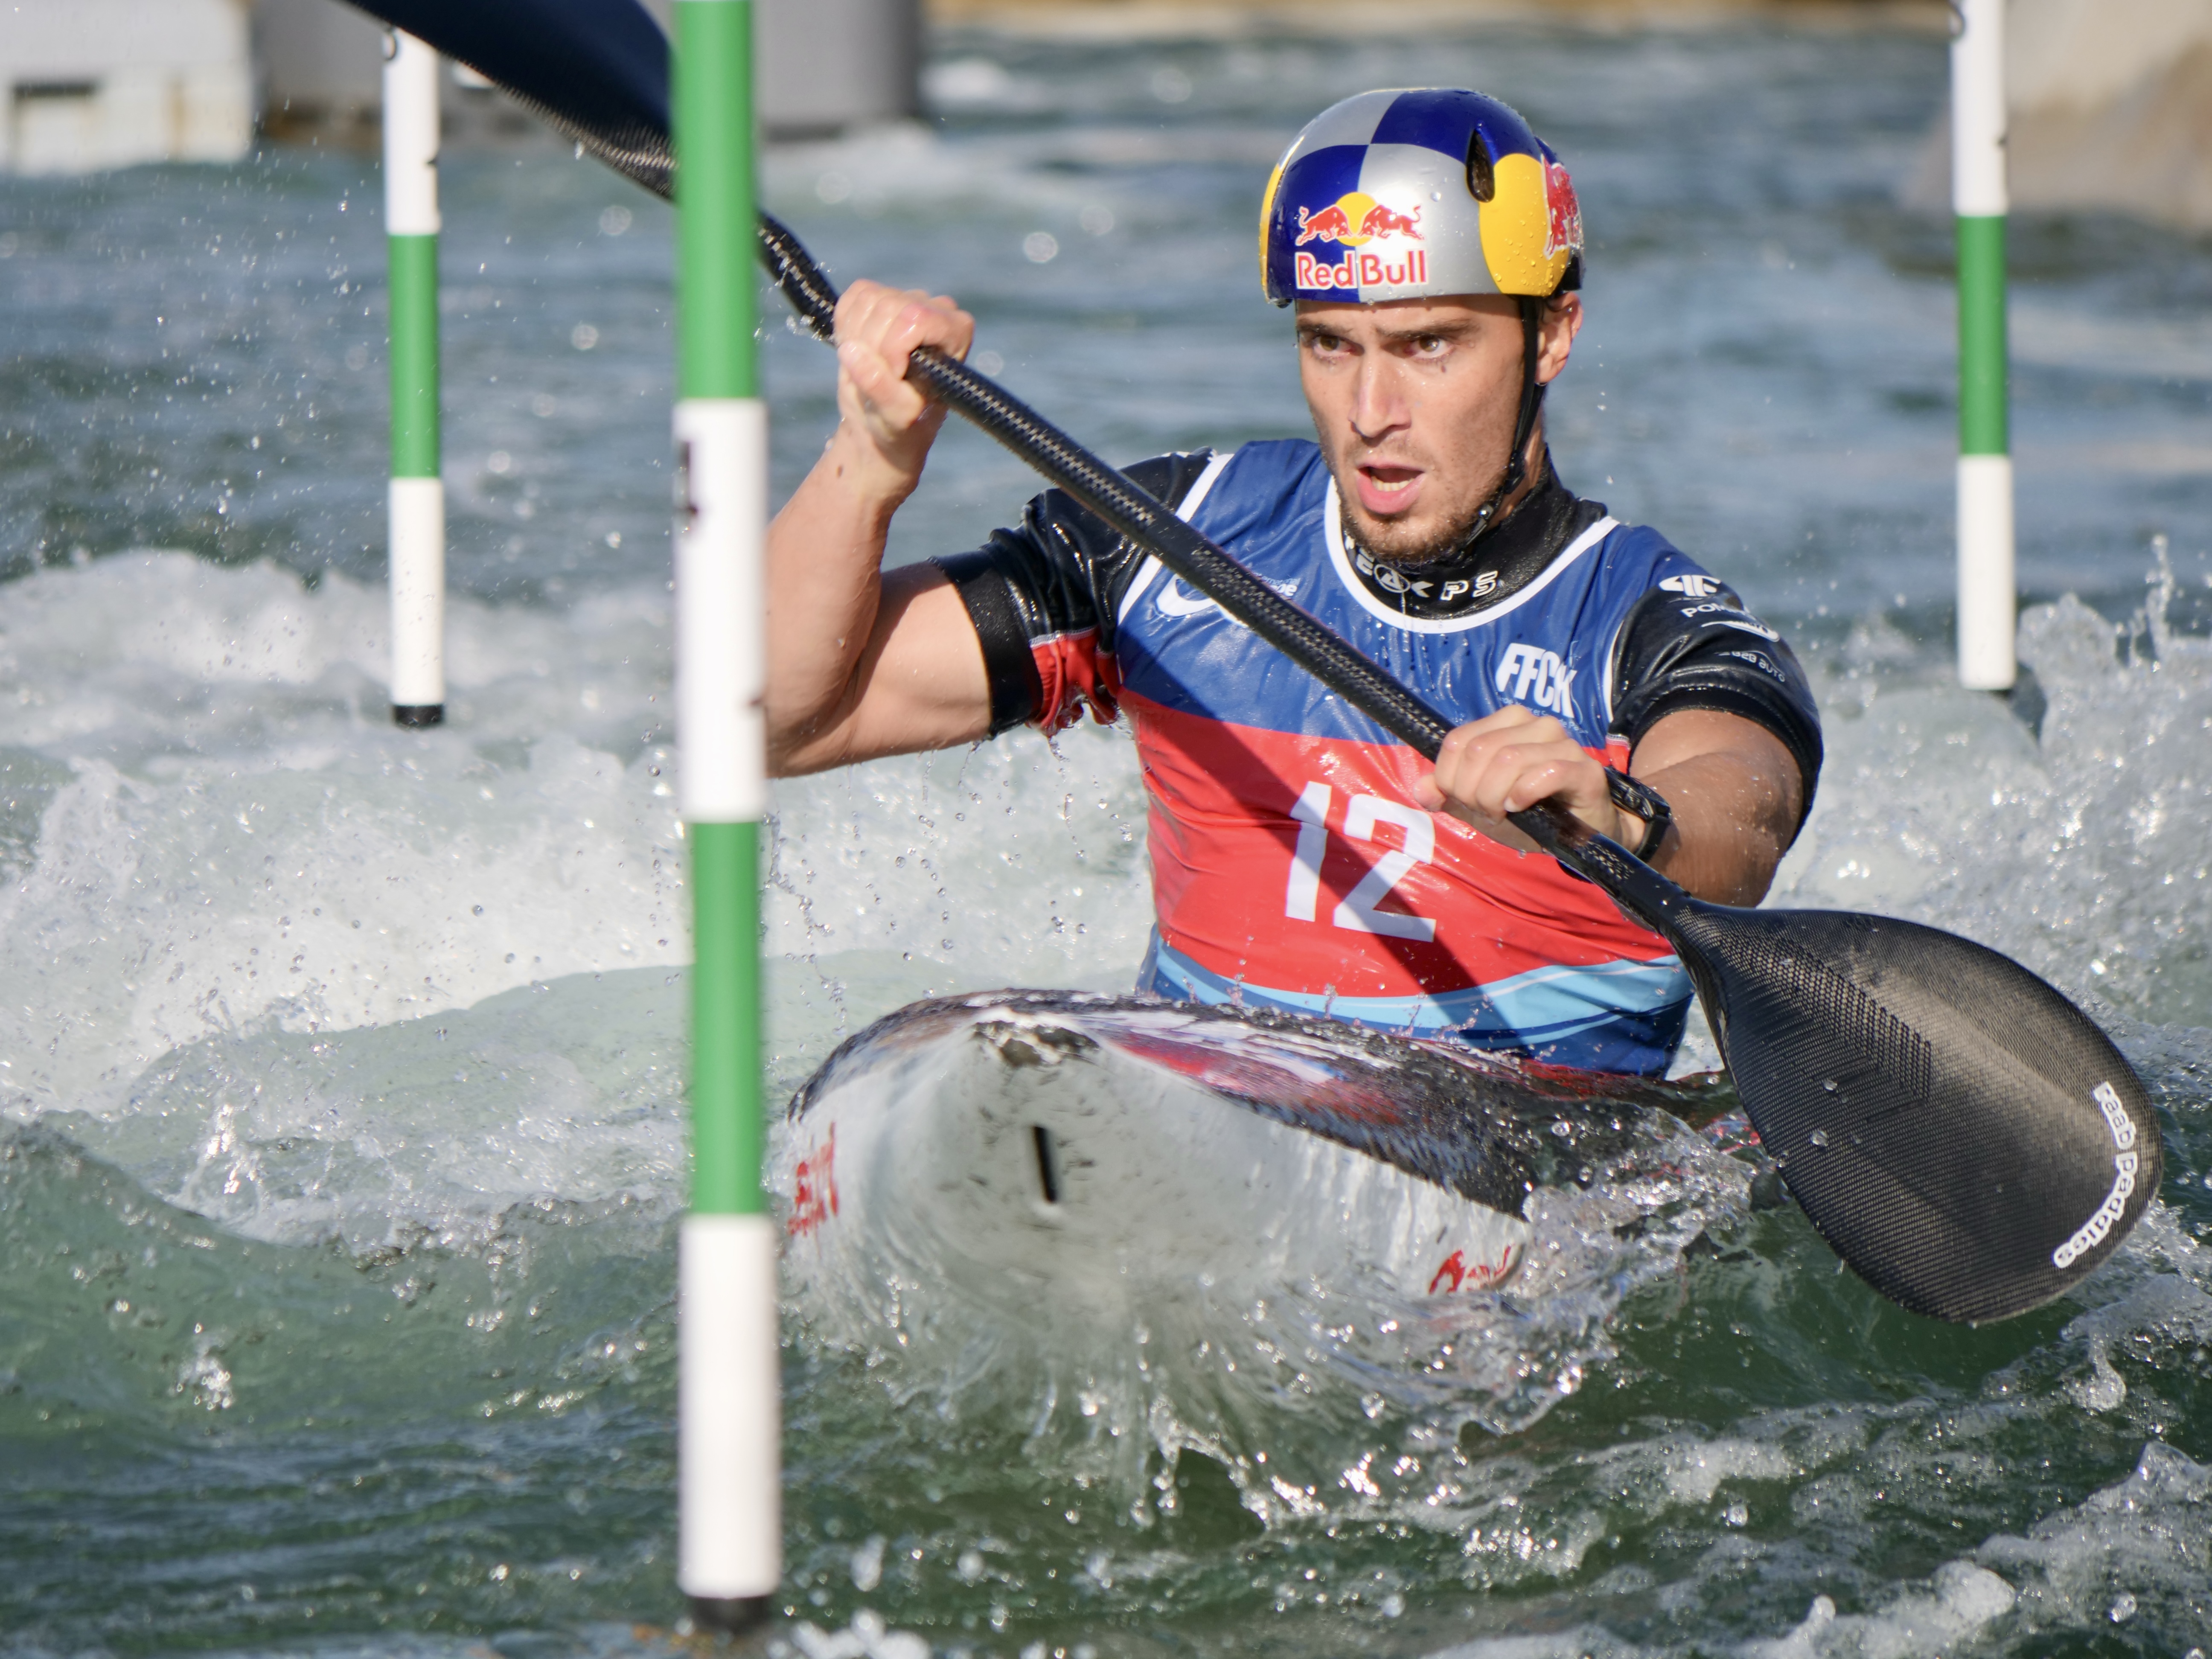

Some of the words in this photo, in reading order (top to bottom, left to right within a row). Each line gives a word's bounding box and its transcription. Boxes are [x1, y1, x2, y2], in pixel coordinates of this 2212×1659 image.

[1296, 252, 1356, 289] Red
[1359, 249, 1428, 286] Bull
[1495, 643, 1578, 719] FFCK
[1285, 780, 1437, 943] 12
